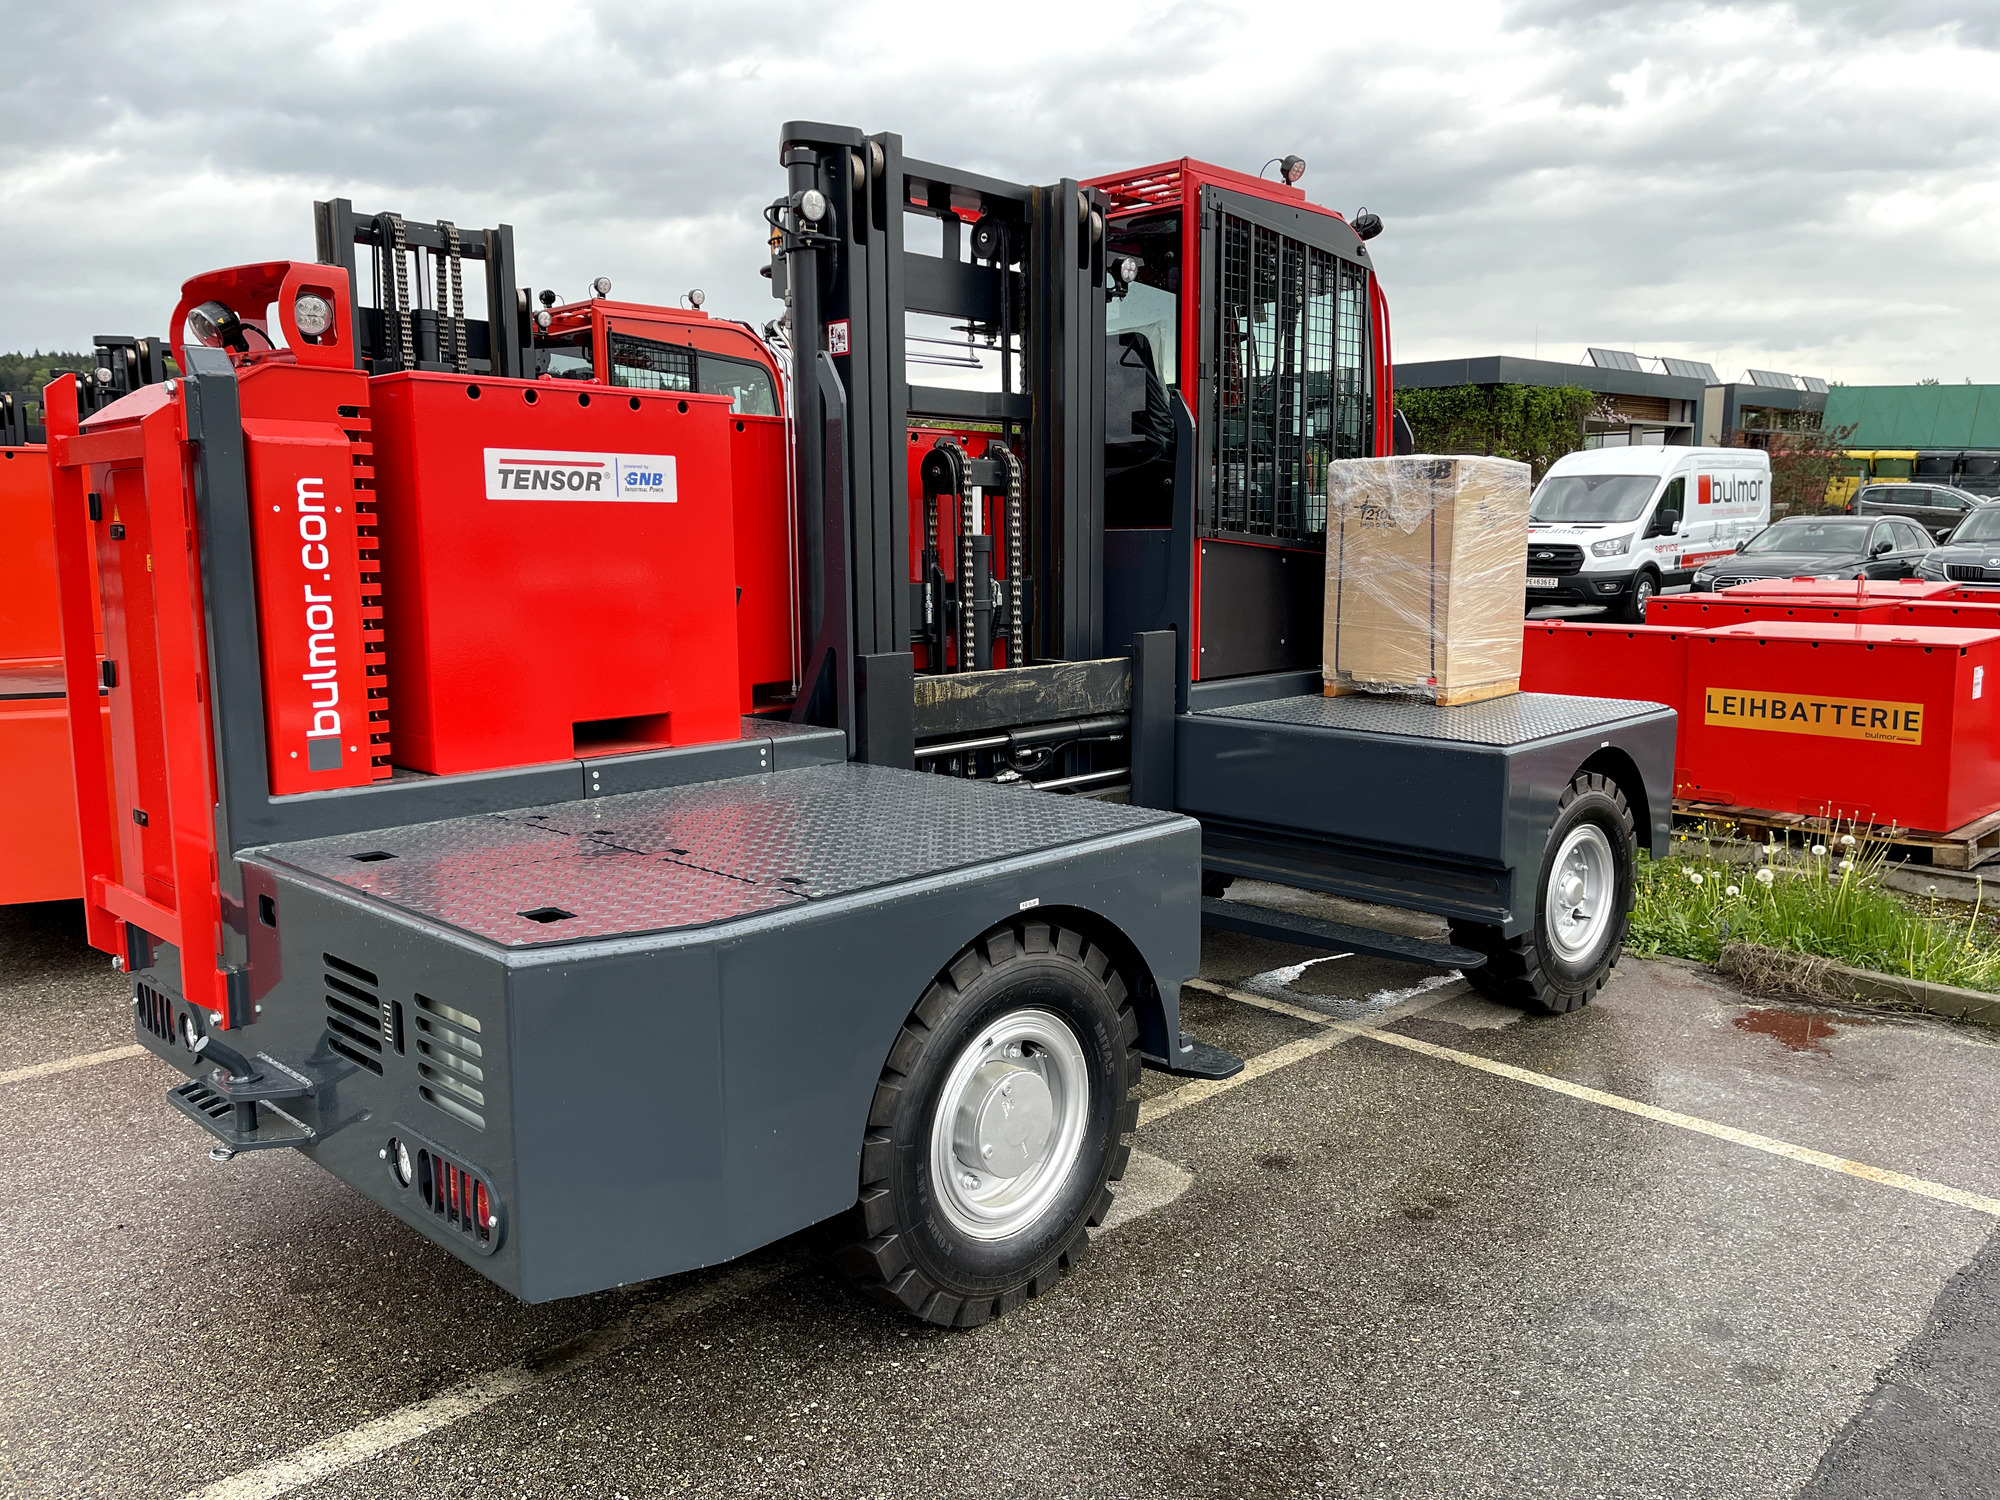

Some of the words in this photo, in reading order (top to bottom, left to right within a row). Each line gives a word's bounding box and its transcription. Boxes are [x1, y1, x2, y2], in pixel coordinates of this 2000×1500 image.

[498, 468, 602, 491] TENSOR
[625, 472, 663, 486] GNB
[1712, 474, 1763, 504] bulmor
[1654, 543, 1678, 554] service
[297, 477, 341, 737] bulmor.com
[1707, 694, 1920, 732] LEIHBATTERIE
[1865, 731, 1896, 740] bulmor
